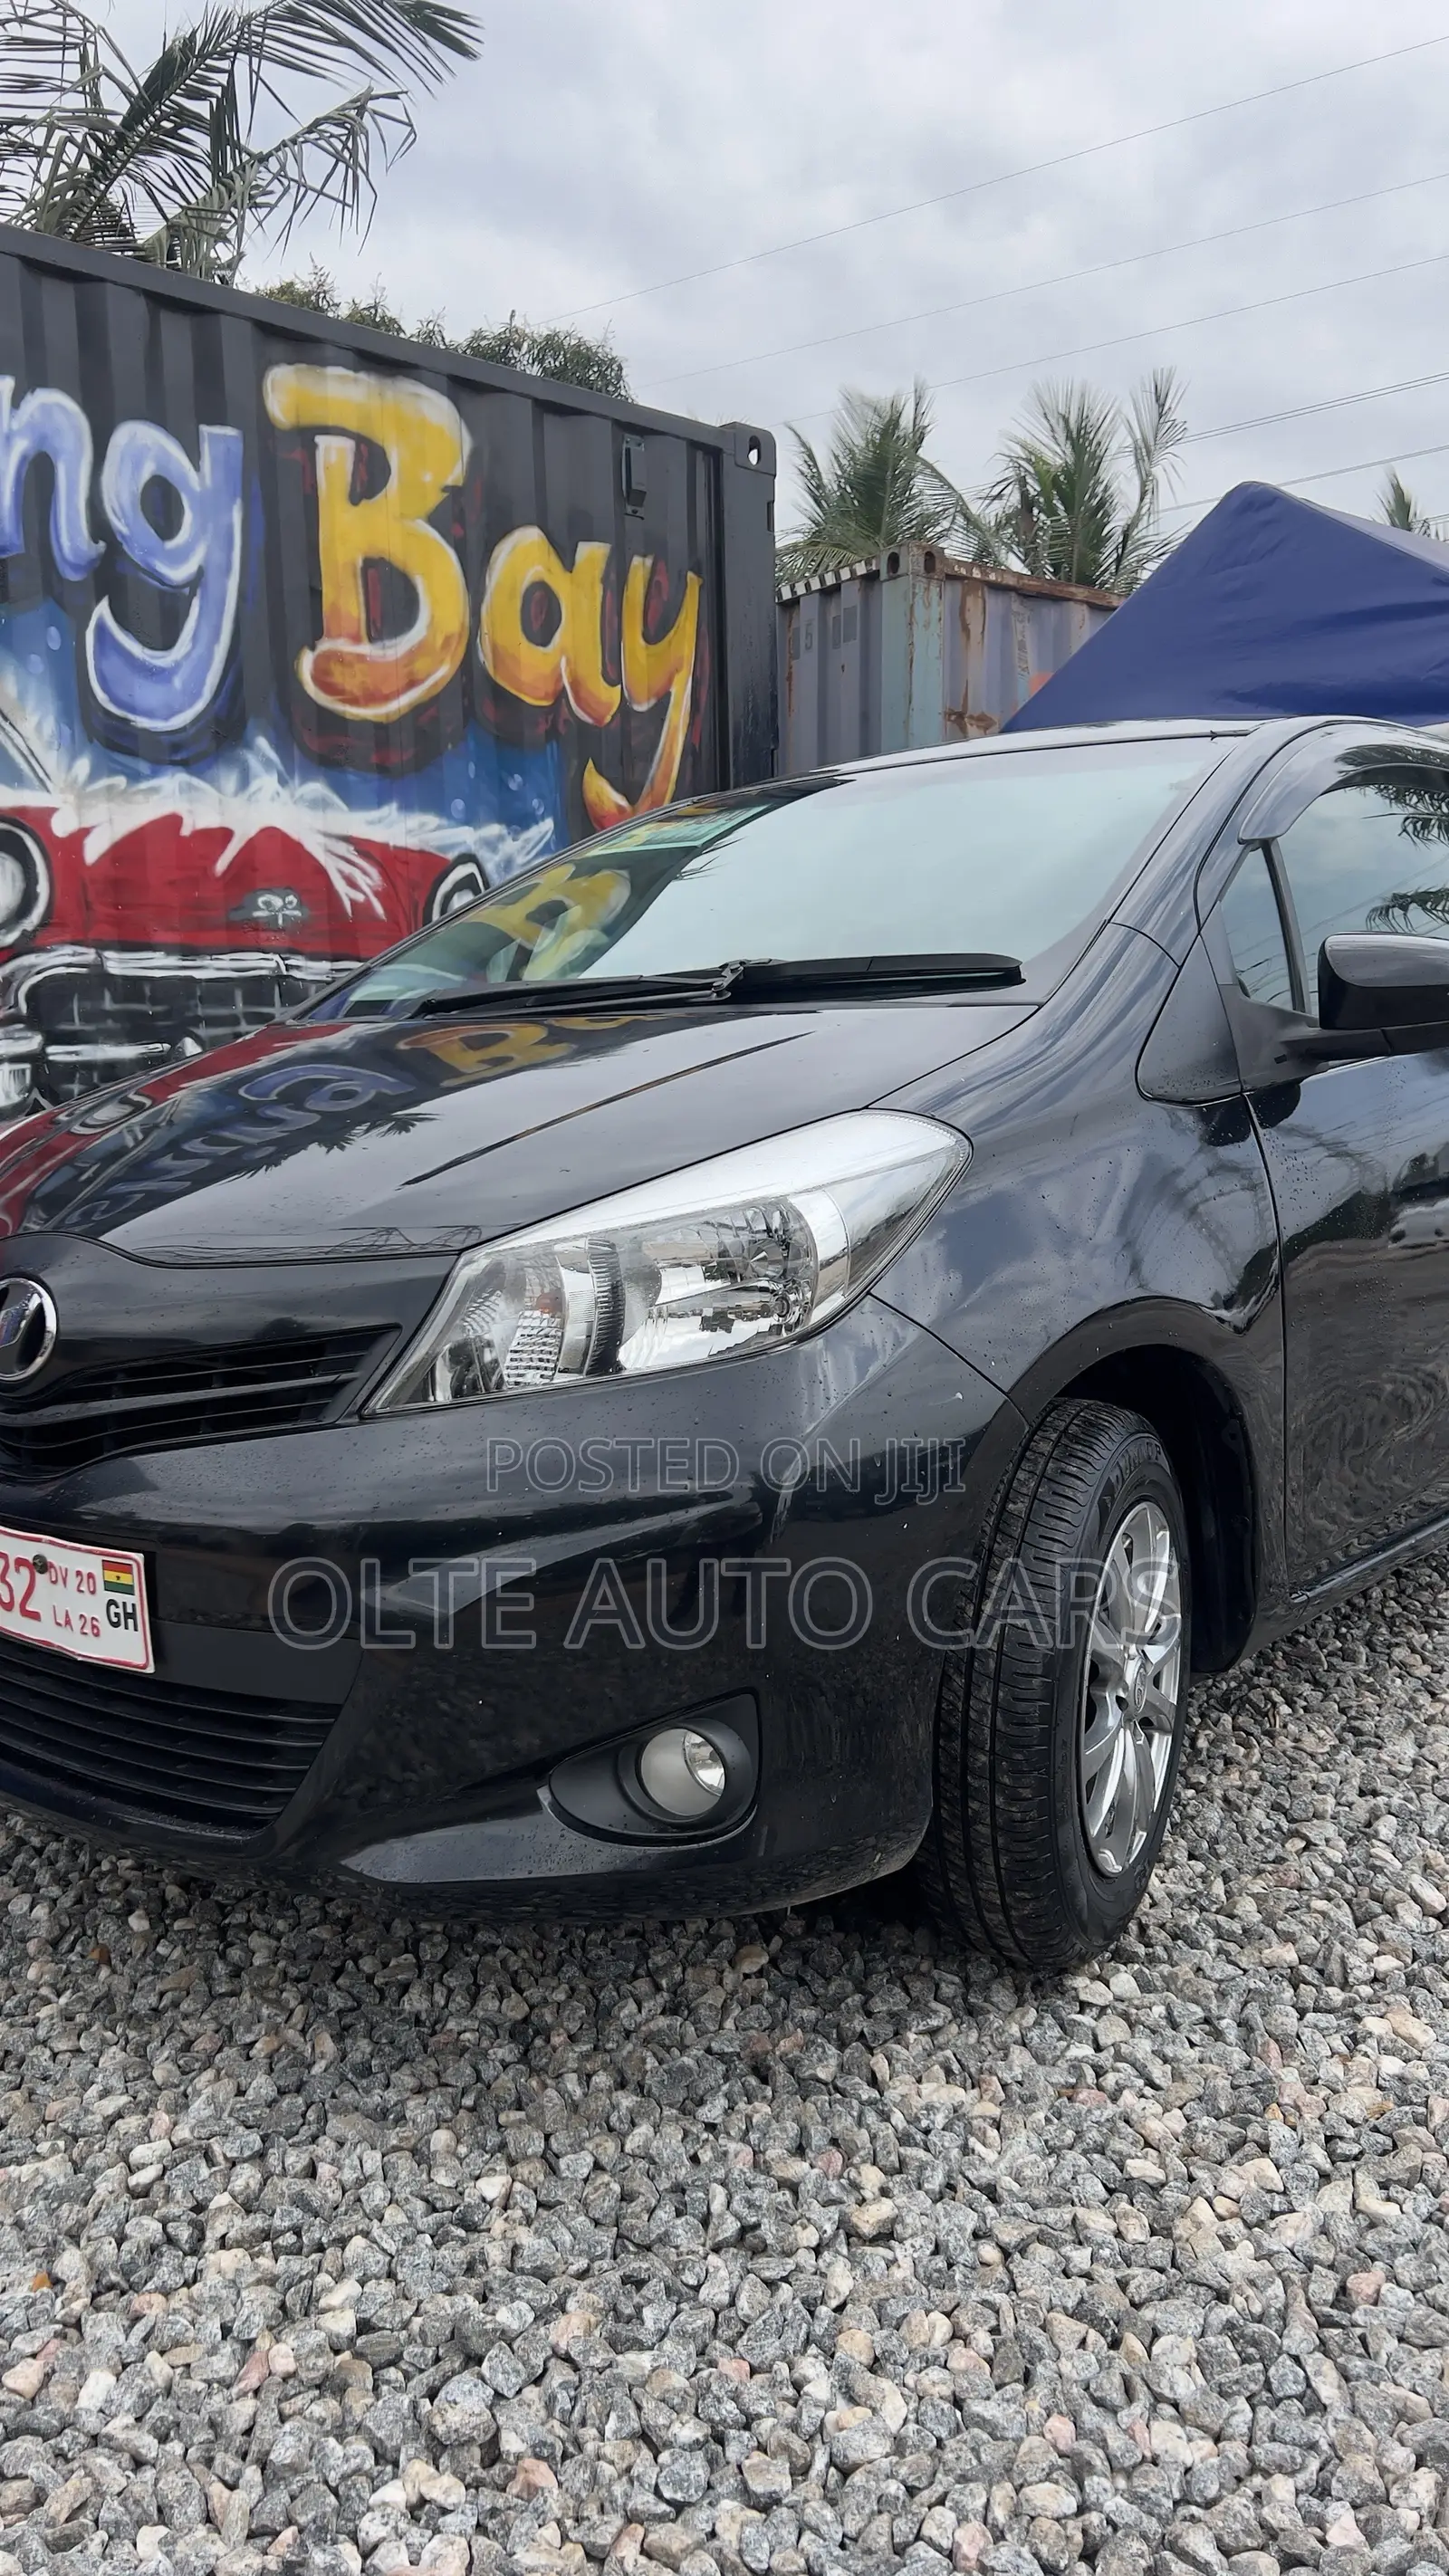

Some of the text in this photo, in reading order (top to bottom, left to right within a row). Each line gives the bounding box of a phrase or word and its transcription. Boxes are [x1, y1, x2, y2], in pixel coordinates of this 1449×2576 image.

[263, 363, 703, 831] Bay
[47, 1560, 97, 1594] DV 20
[53, 1604, 101, 1637] LA 26
[106, 1598, 139, 1632] GH
